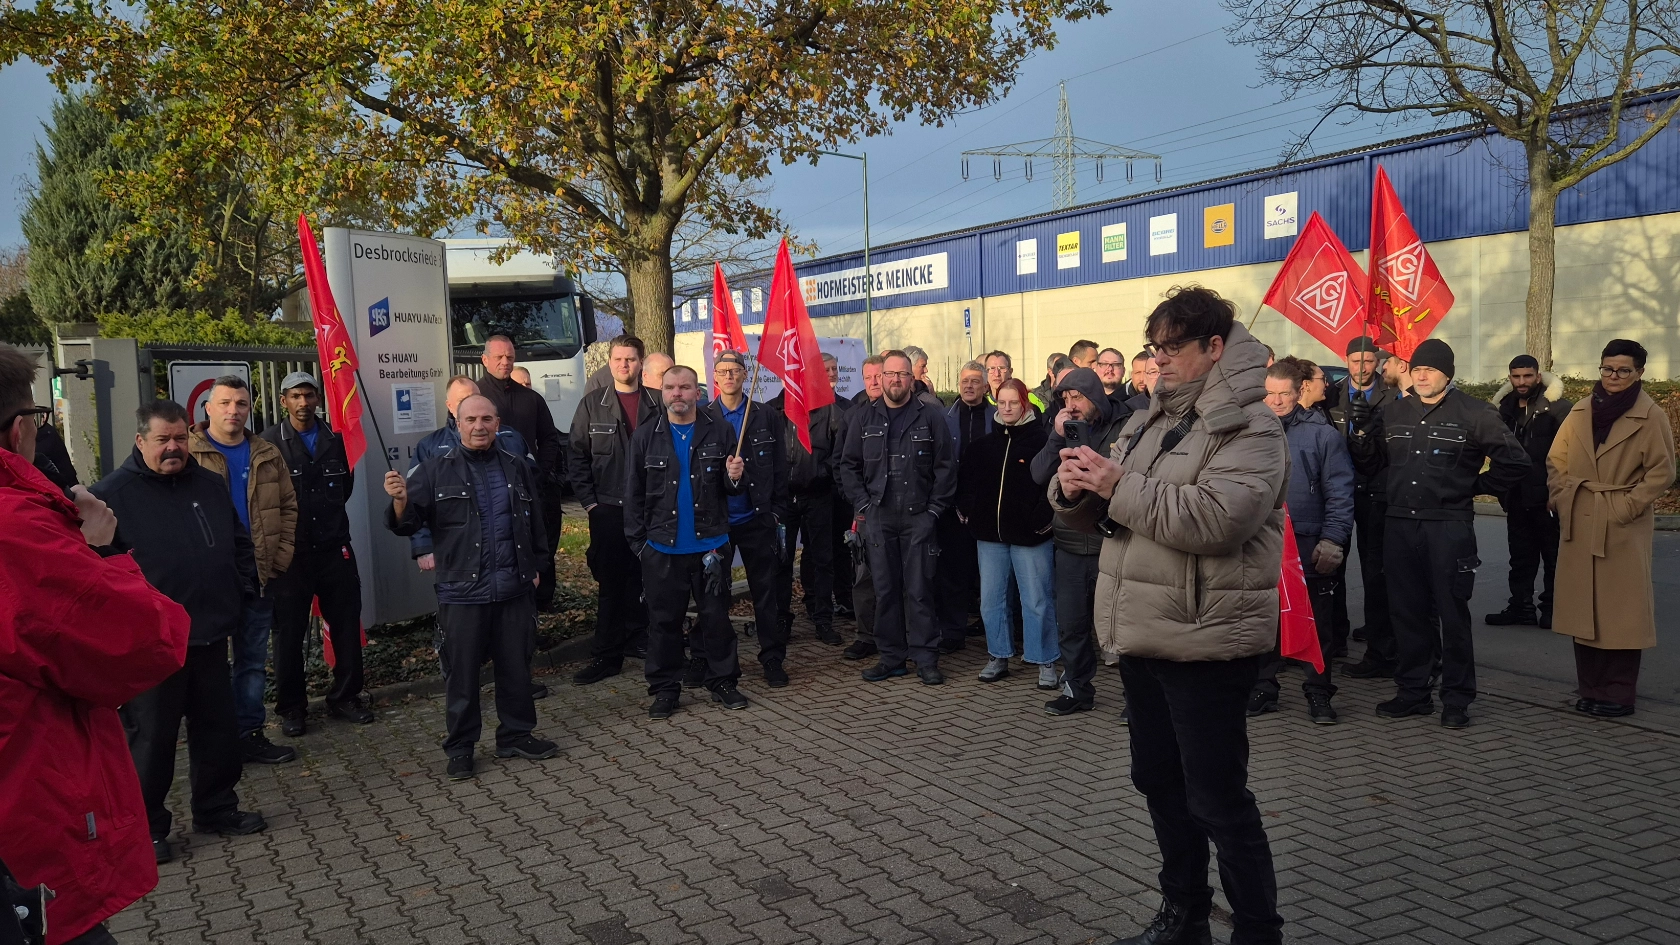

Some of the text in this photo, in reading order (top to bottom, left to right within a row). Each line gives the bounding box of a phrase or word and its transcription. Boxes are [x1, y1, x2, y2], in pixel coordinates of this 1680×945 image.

[1266, 216, 1295, 228] SACHS
[1058, 242, 1079, 252] TEXTAR
[1104, 242, 1125, 252] FILTER
[353, 242, 437, 267] Desbrocksriede
[816, 263, 933, 300] HOFMEISTER & MEINCKE
[394, 312, 422, 323] HUAYU
[378, 353, 418, 364] KS HUAYU
[379, 368, 429, 380] Bearbeitungs
